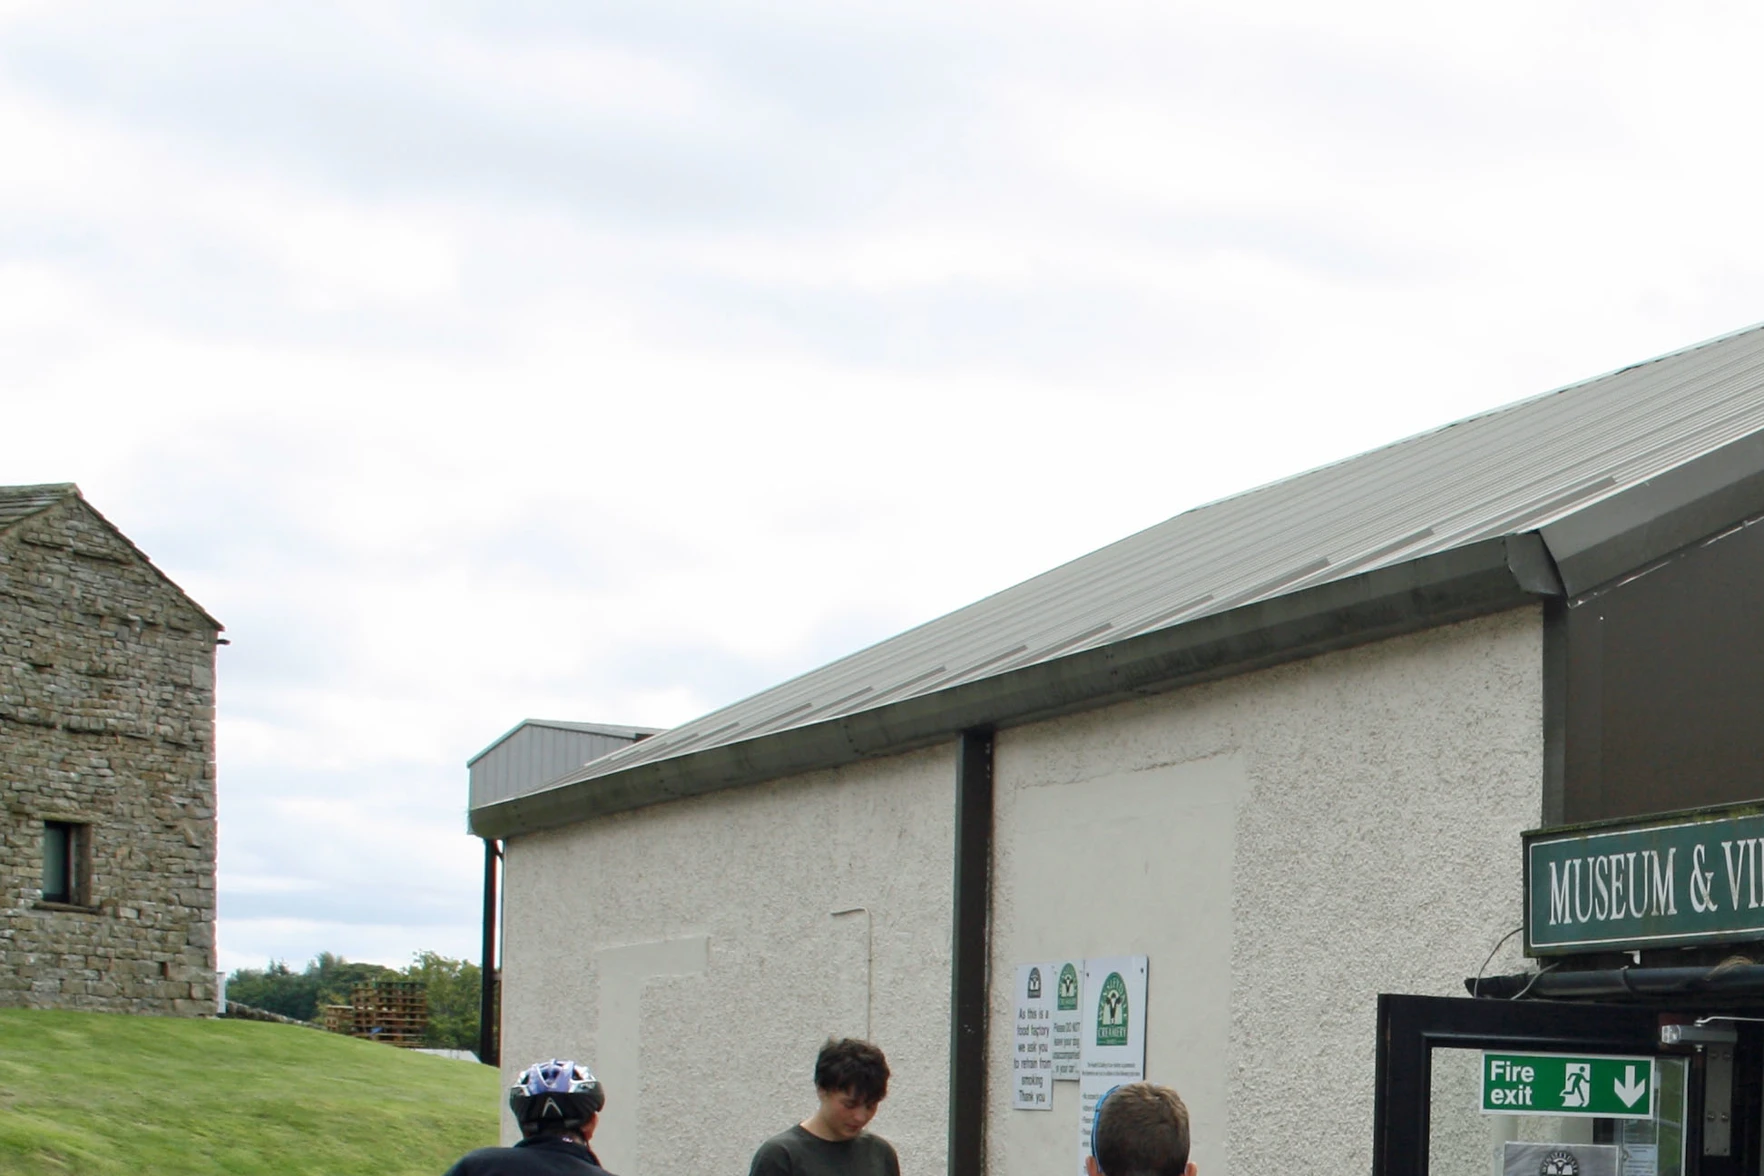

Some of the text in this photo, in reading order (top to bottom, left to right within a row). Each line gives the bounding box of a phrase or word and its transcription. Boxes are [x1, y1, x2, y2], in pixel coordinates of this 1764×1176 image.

[1548, 847, 1677, 926] MUSEUM
[1689, 847, 1717, 913] &
[1019, 1008, 1026, 1019] As
[1027, 1008, 1037, 1019] this
[1039, 1009, 1043, 1019] is
[1017, 1024, 1049, 1038] food factory
[1018, 1041, 1048, 1055] we ask you
[1014, 1058, 1052, 1068] to refrain from
[1490, 1061, 1535, 1082] Fire
[1022, 1075, 1043, 1089] smoking
[1019, 1090, 1045, 1105] Thank you
[1490, 1085, 1532, 1106] exit
